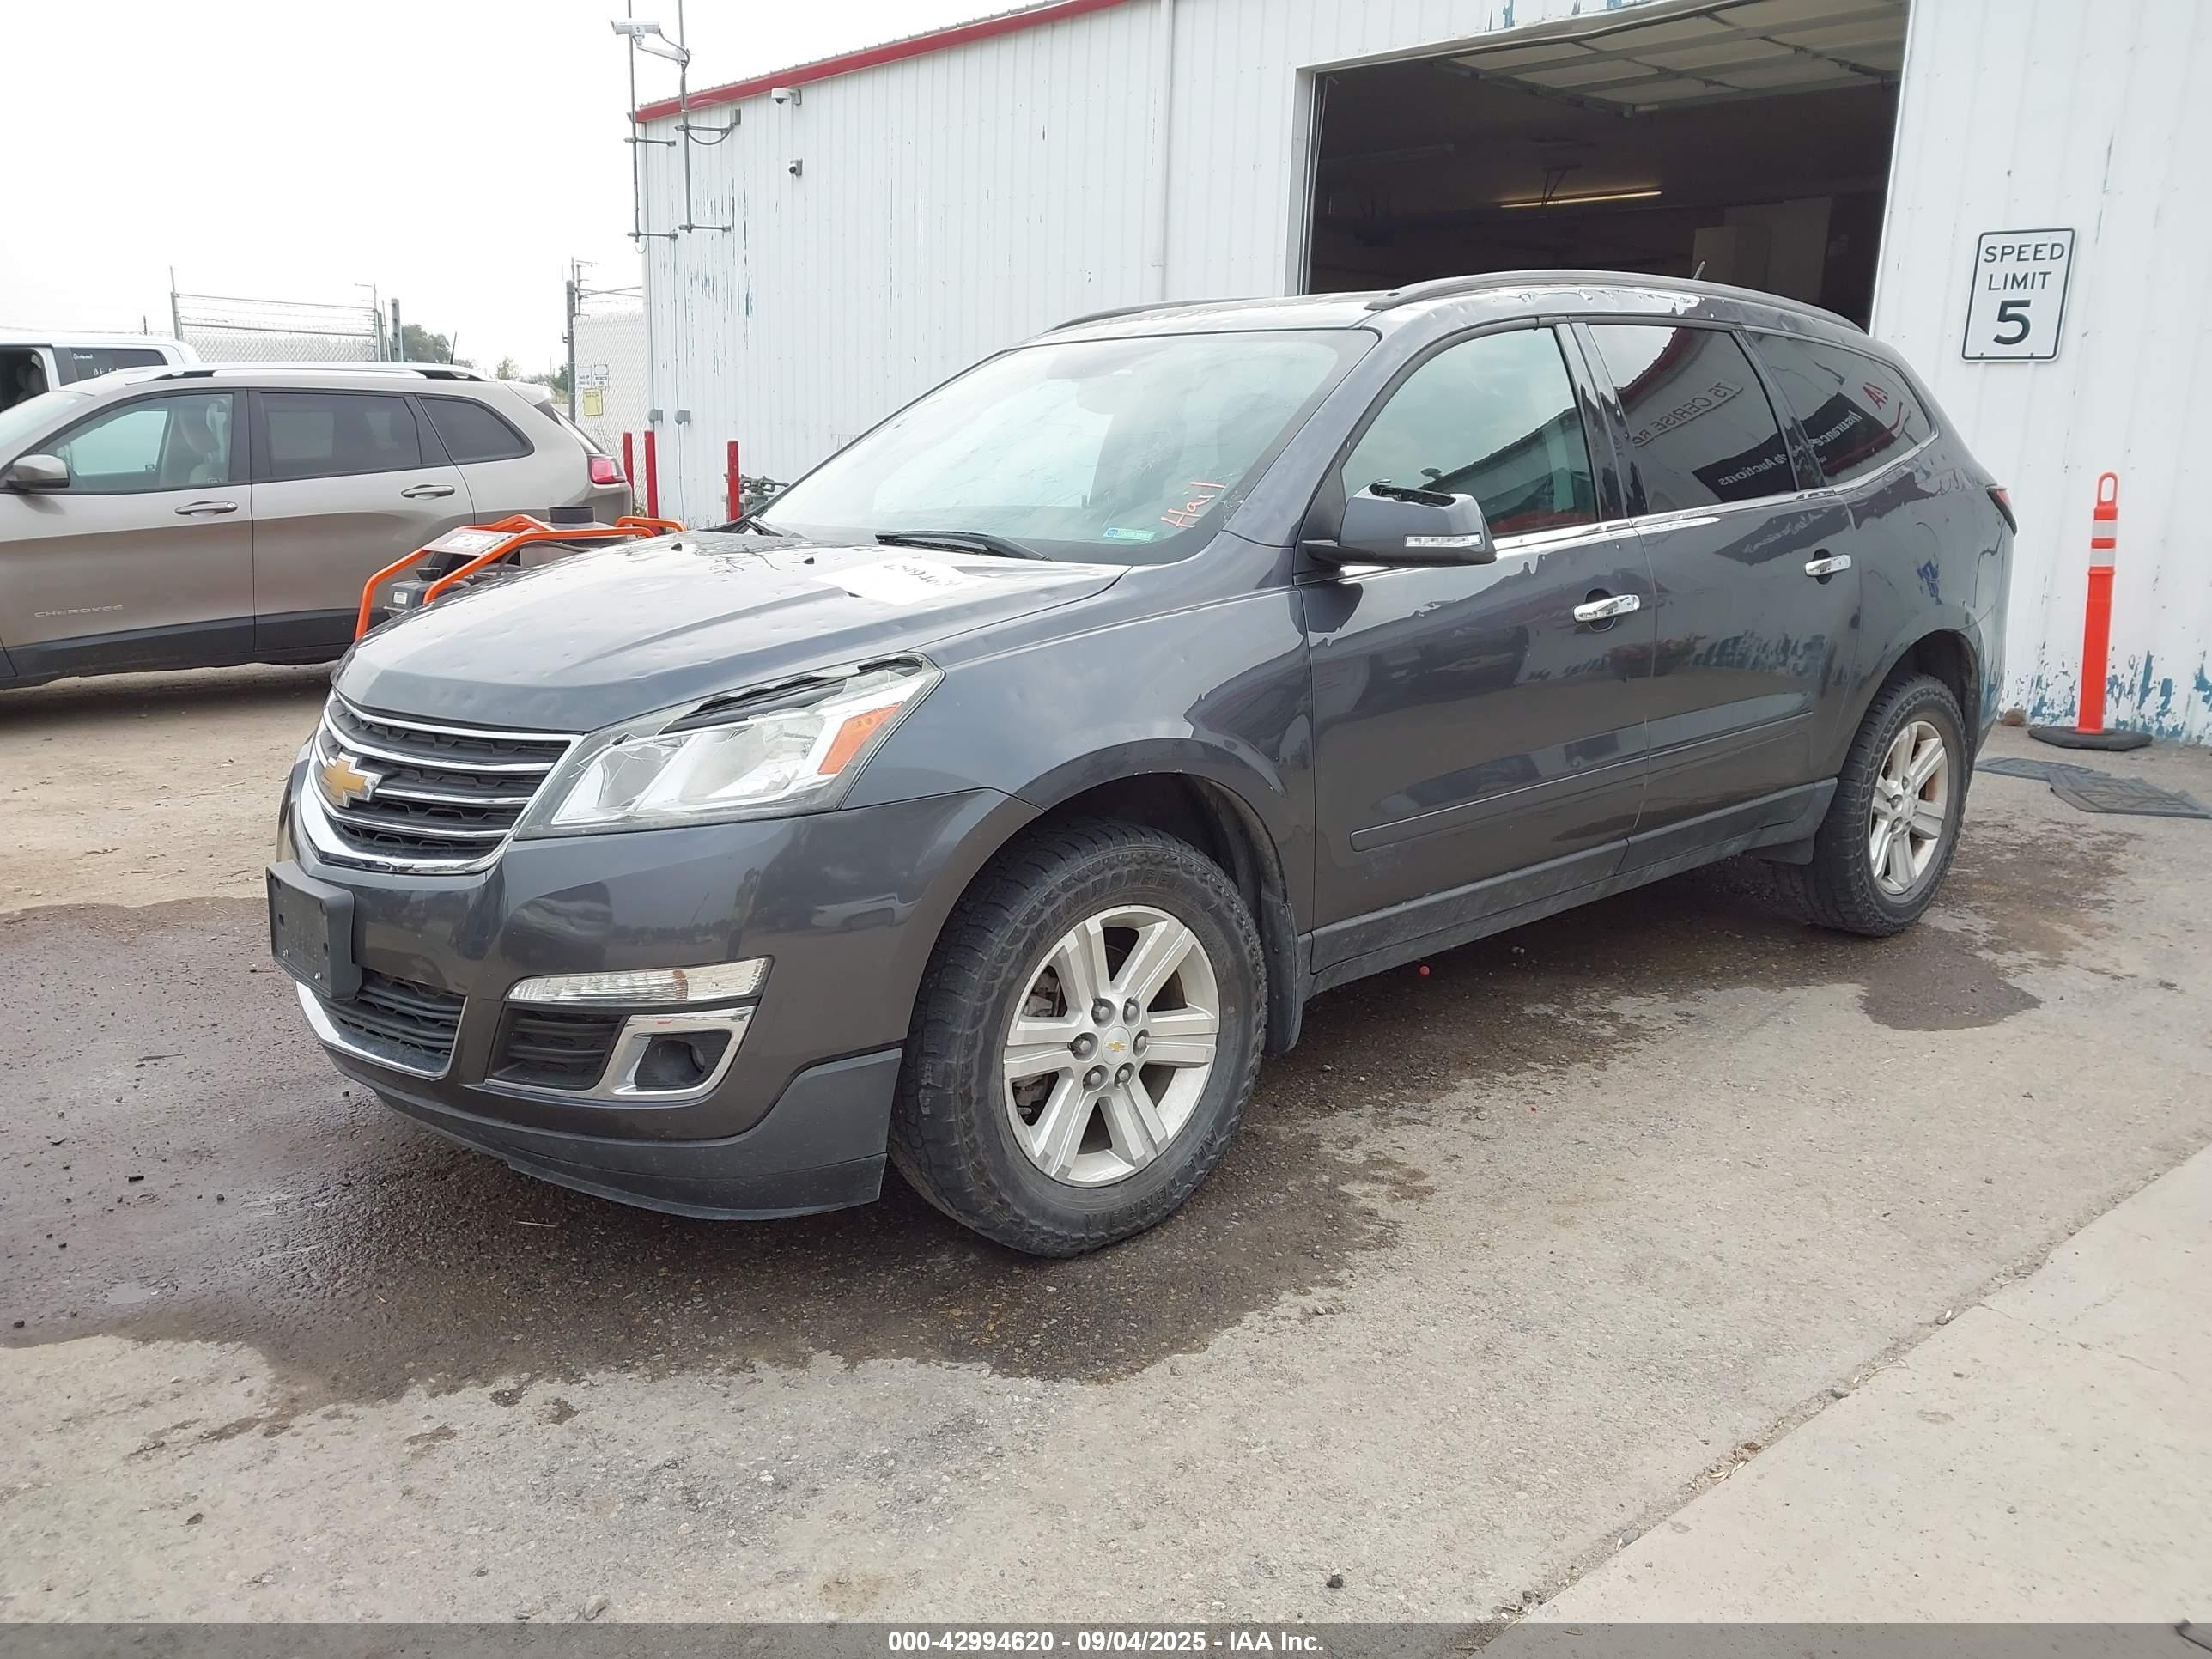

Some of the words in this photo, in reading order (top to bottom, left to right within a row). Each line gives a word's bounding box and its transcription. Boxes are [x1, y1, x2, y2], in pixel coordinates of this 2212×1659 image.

[1984, 242, 2065, 264] SPEED
[1987, 271, 2052, 291] LIMIT
[1992, 299, 2032, 345] 5
[33, 604, 124, 618] CHEROKEE
